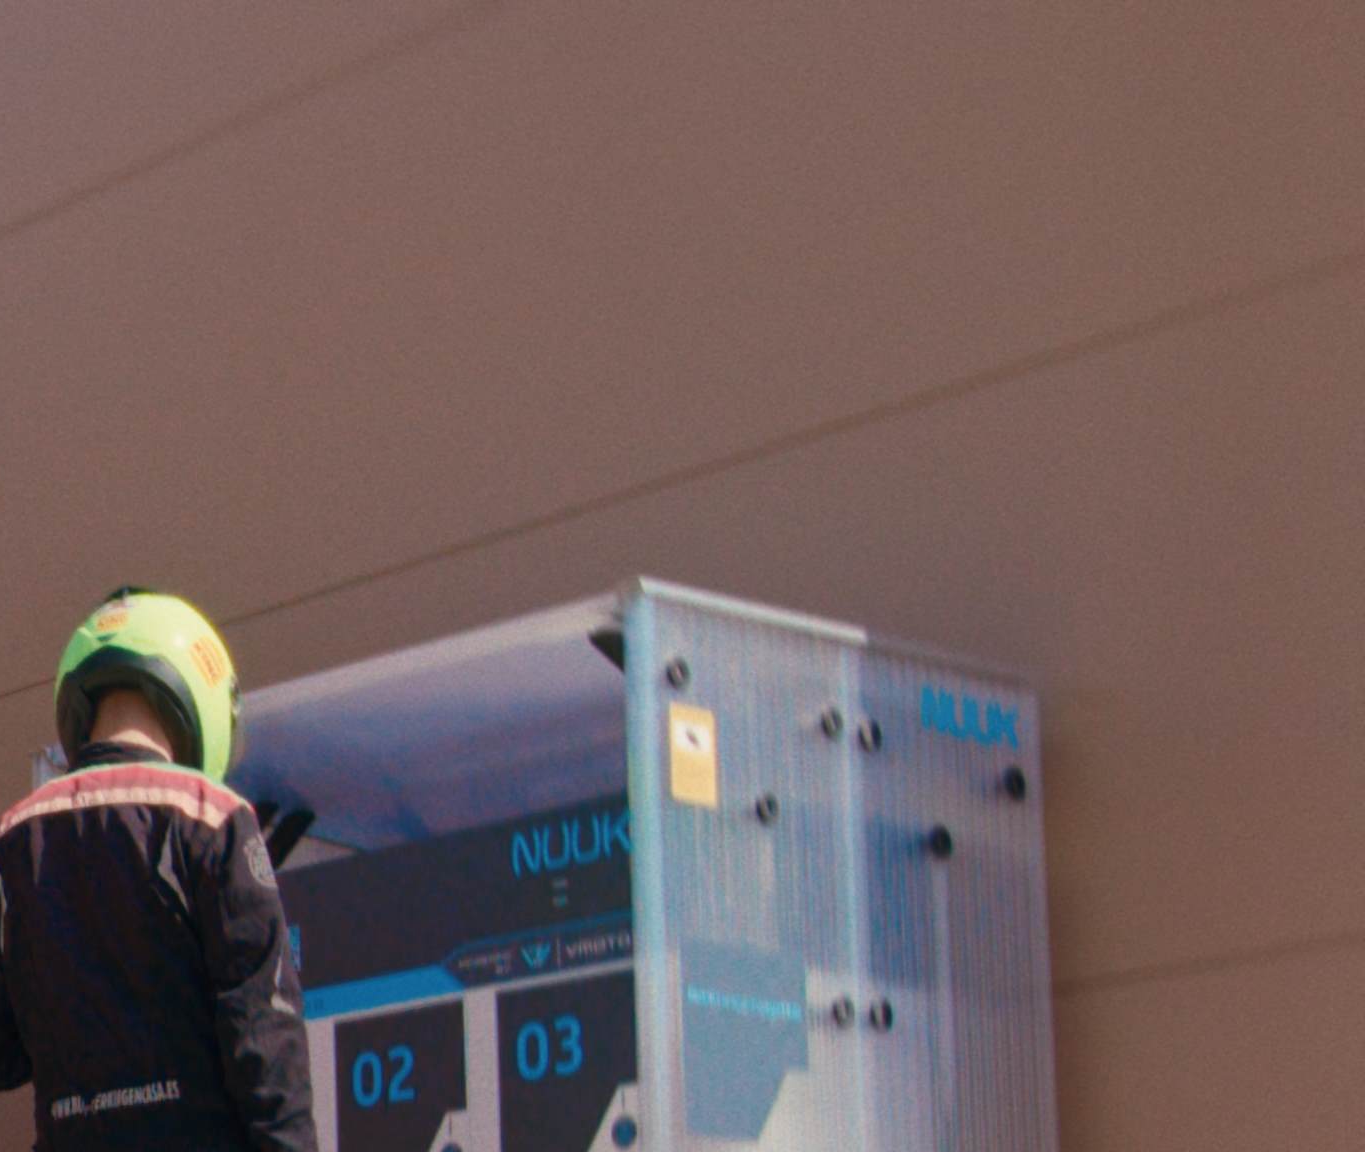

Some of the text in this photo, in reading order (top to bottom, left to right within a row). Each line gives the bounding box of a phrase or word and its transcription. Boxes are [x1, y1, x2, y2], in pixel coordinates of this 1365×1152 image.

[920, 684, 1018, 751] NUUK
[510, 811, 635, 879] NUUK
[352, 1044, 415, 1108] 02
[518, 1013, 584, 1081] 03
